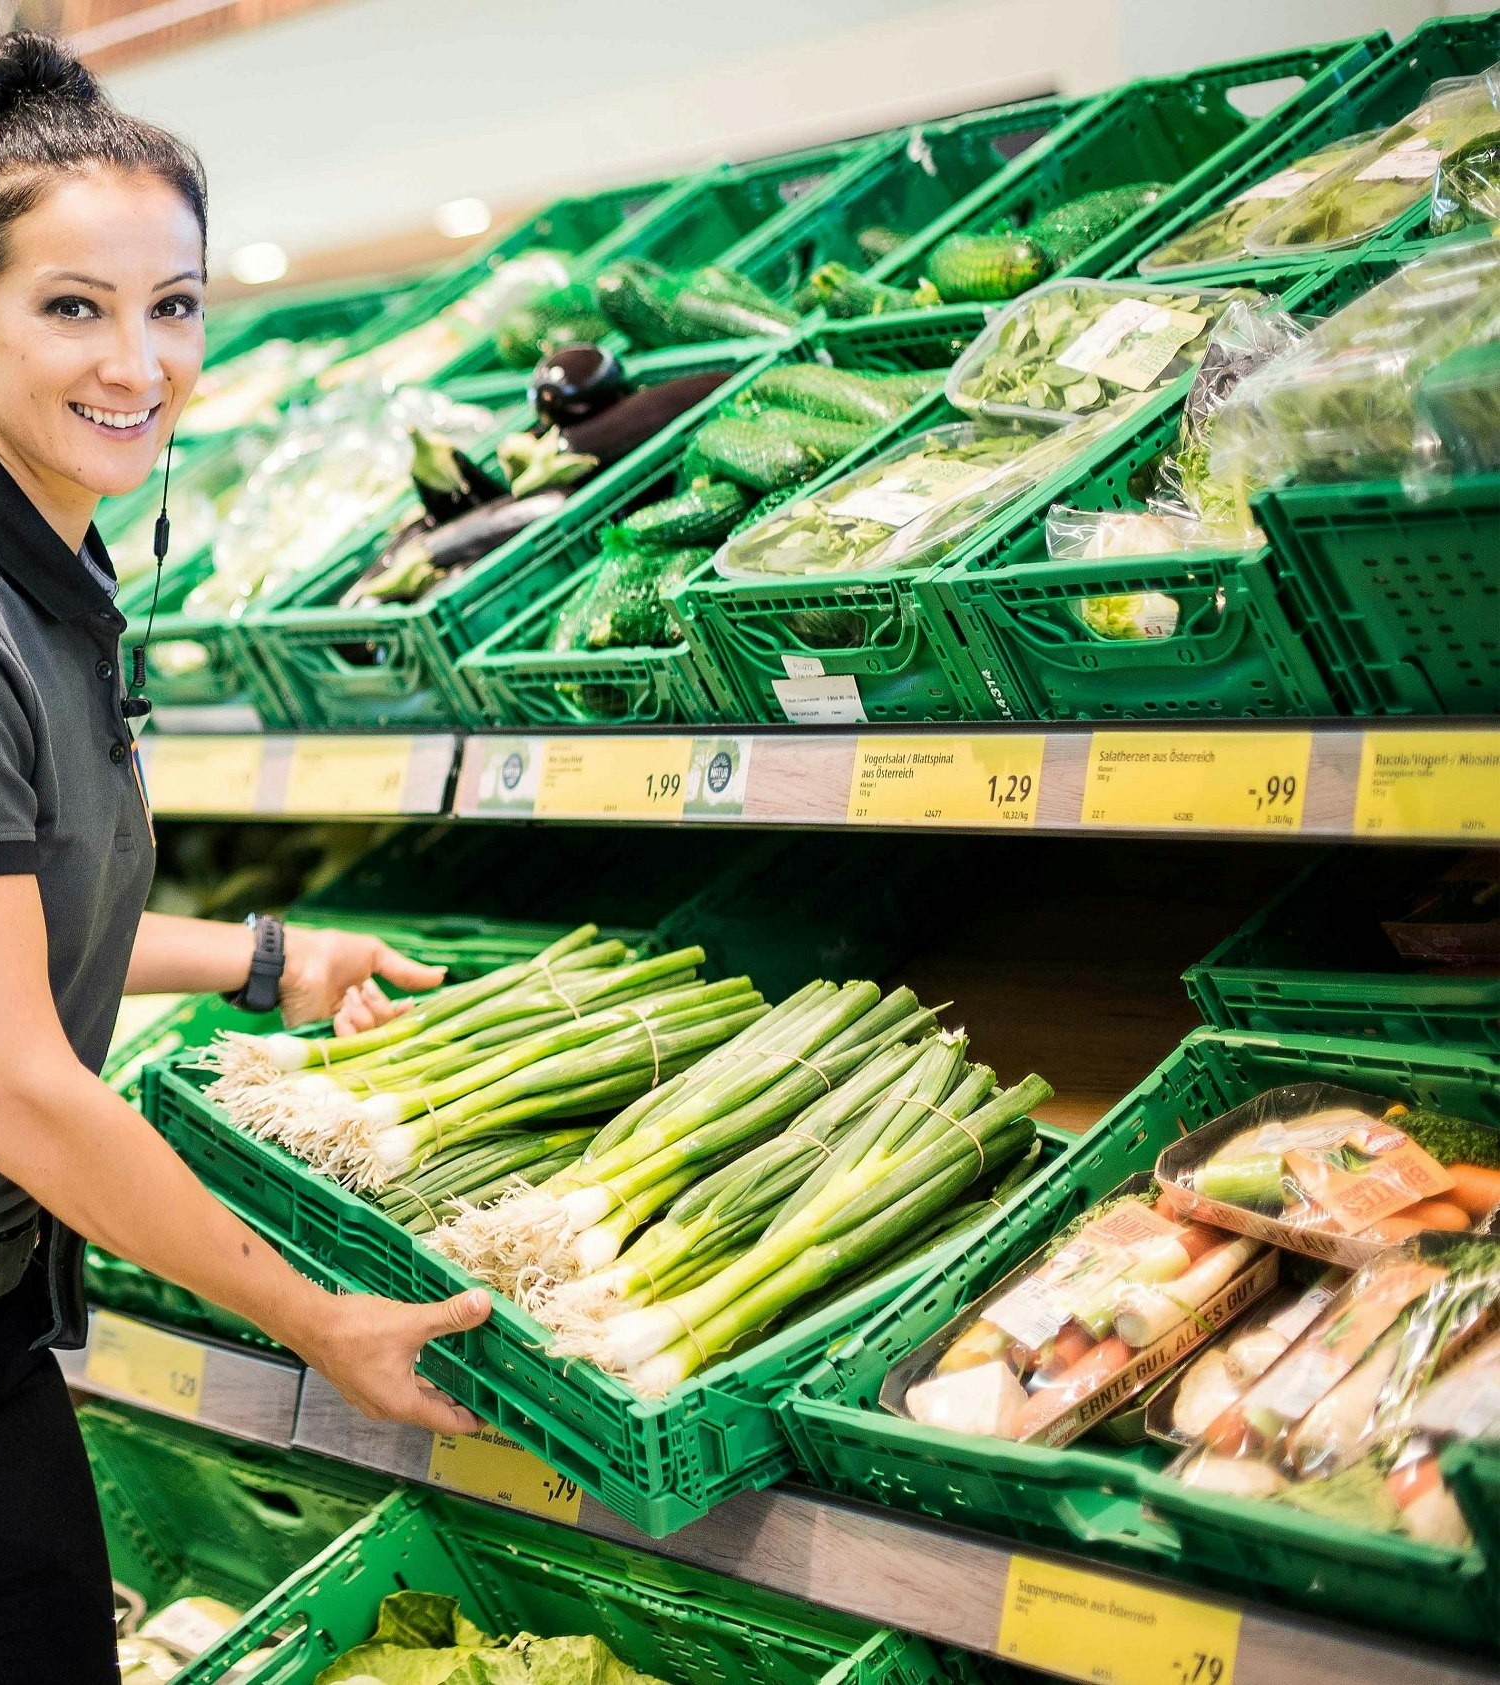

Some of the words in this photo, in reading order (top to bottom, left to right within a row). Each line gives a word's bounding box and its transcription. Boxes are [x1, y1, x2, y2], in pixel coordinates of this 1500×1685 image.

[864, 753, 906, 768] Vogerlsalat
[913, 752, 954, 768] Blattspinat
[1099, 750, 1150, 762] Salatherzen
[1152, 753, 1167, 762] aus
[1169, 749, 1216, 763] Österreich
[861, 769, 875, 779] aus
[876, 766, 914, 779] Österreich
[646, 774, 681, 802] 1,99
[988, 775, 1032, 808] 1,29
[1248, 775, 1296, 811] -,99
[924, 810, 942, 819] 42477
[1002, 811, 1029, 822] 10,32/kg
[1078, 1378, 1134, 1424] ERNTE
[1227, 1275, 1257, 1313] GUT
[543, 1473, 577, 1502] -,79
[1017, 1578, 1090, 1610] Suppengemüse
[1091, 1600, 1107, 1613] aus
[1108, 1599, 1157, 1627] Österreich
[1172, 1651, 1224, 1685] -,79
